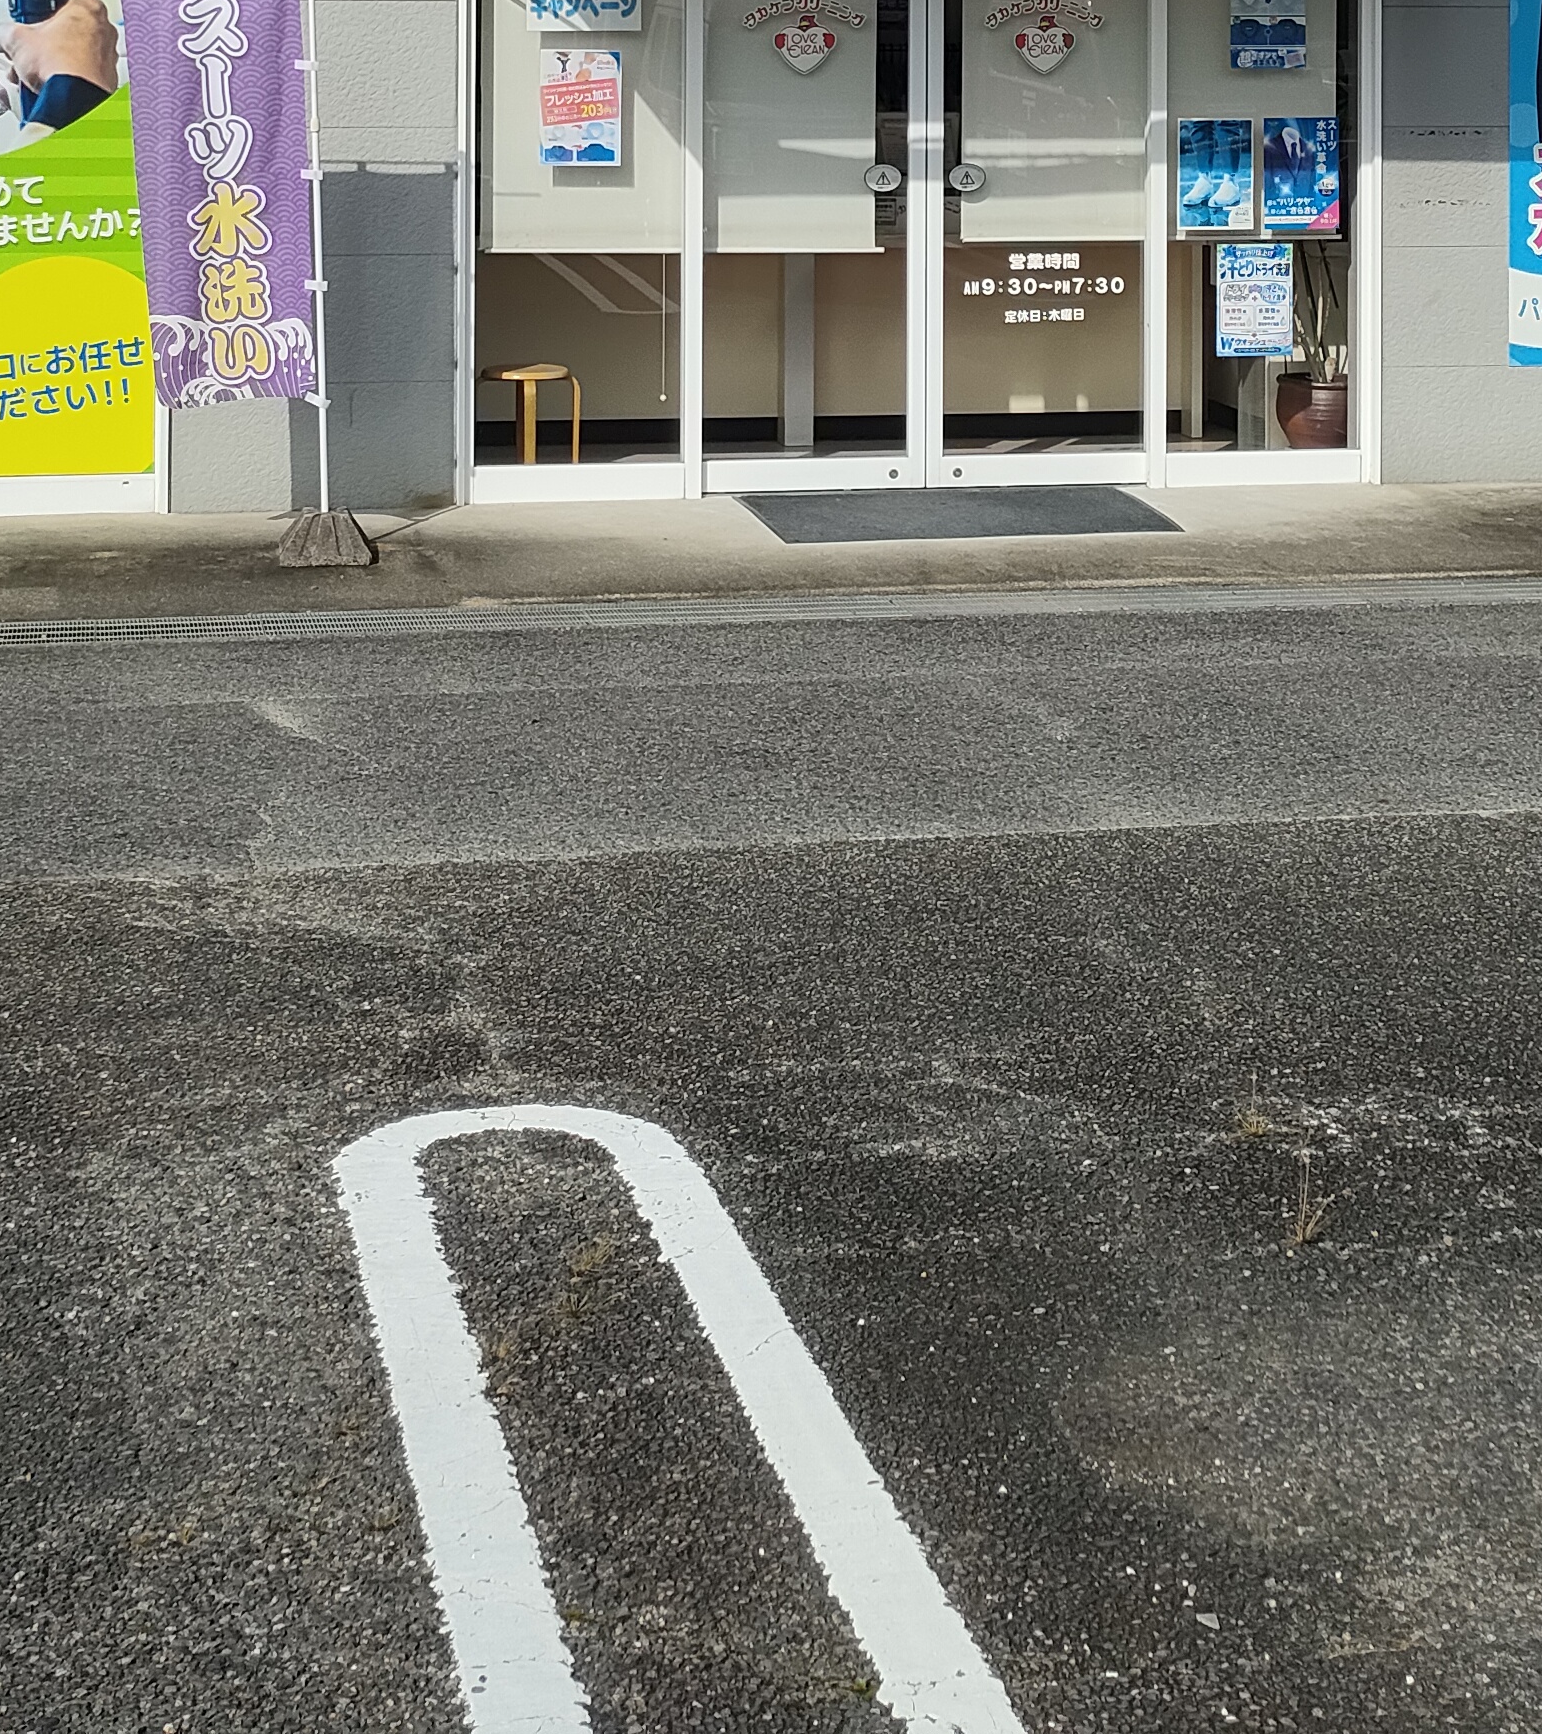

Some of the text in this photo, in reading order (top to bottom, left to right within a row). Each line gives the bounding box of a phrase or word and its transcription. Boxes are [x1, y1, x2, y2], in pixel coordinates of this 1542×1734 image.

[544, 88, 615, 106] フレッシュ加工
[1328, 119, 1338, 152] スーツ
[1008, 252, 1081, 271] 営業時間
